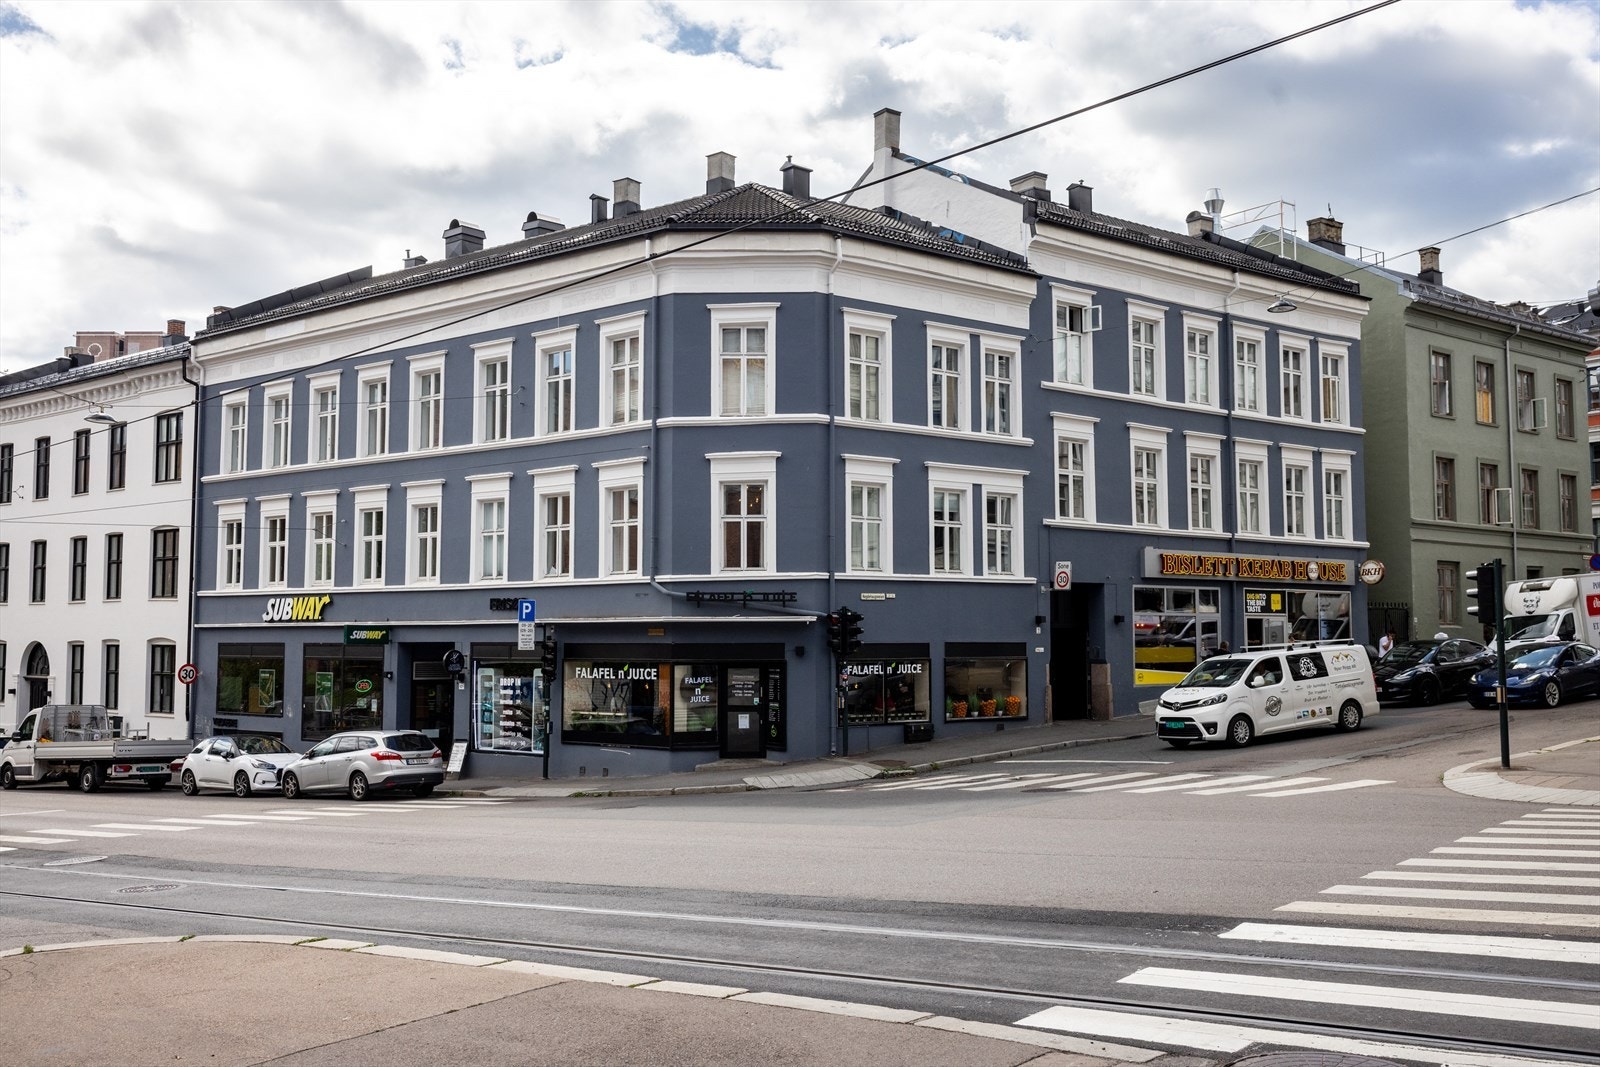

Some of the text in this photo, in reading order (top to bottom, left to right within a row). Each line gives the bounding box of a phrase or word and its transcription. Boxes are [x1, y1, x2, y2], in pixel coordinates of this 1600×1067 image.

[1160, 553, 1236, 577] BISLETT
[1237, 557, 1294, 580] KEBAB
[1361, 566, 1381, 577] BKH
[1058, 575, 1067, 584] 30
[262, 594, 332, 622] SUBWAY
[522, 602, 532, 619] P
[350, 630, 386, 639] SUBWAY
[181, 668, 195, 679] 30
[575, 667, 616, 679] FALAFEL
[627, 668, 657, 680] JUICE
[847, 664, 884, 675] FALAFEL
[896, 664, 922, 674] JUICE
[500, 677, 521, 686] DROP IN
[684, 676, 713, 684] FALAFEL
[690, 695, 710, 703] JUICE
